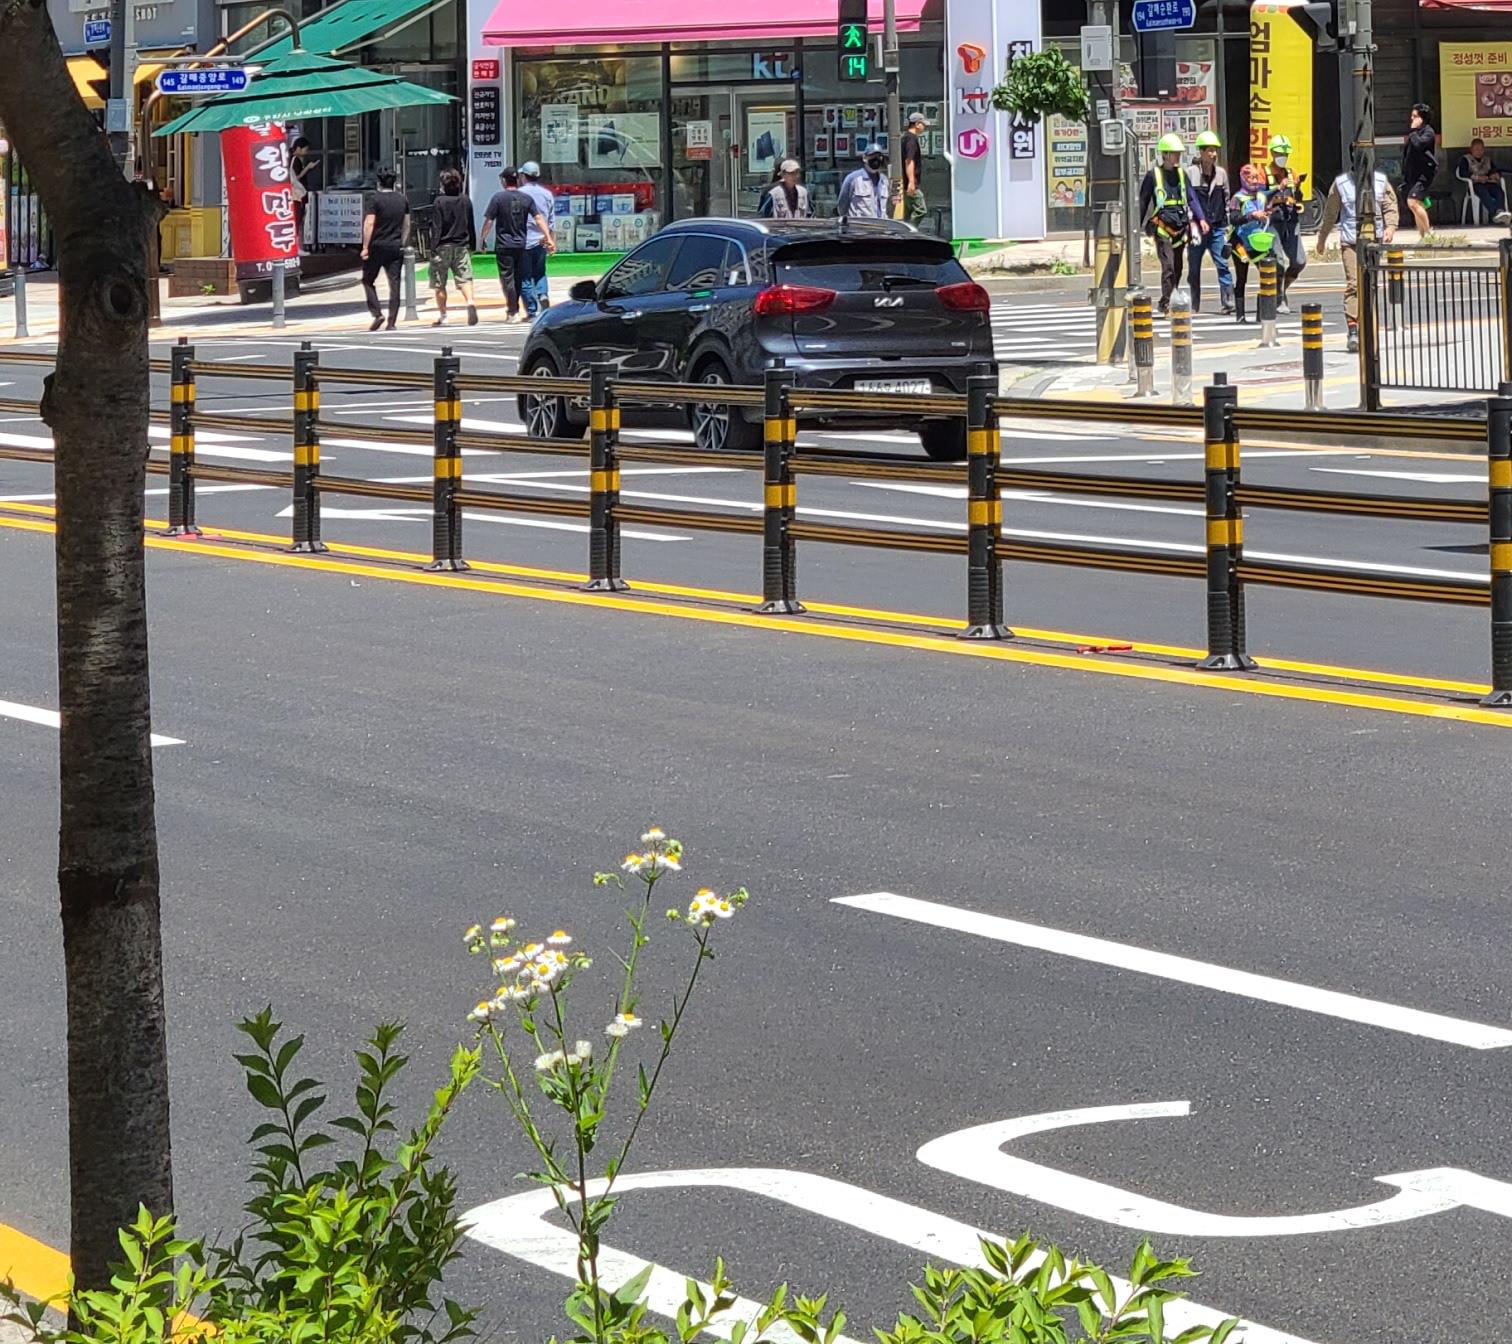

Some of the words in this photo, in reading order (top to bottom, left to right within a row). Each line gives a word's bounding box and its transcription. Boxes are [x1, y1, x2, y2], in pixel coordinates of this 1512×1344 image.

[1452, 52, 1484, 65] 정성껏
[1487, 53, 1508, 64] 준비
[848, 58, 865, 76] 14
[179, 72, 227, 84] 갈매중앙로
[957, 87, 988, 114] kt
[1471, 125, 1503, 138] 마음껏
